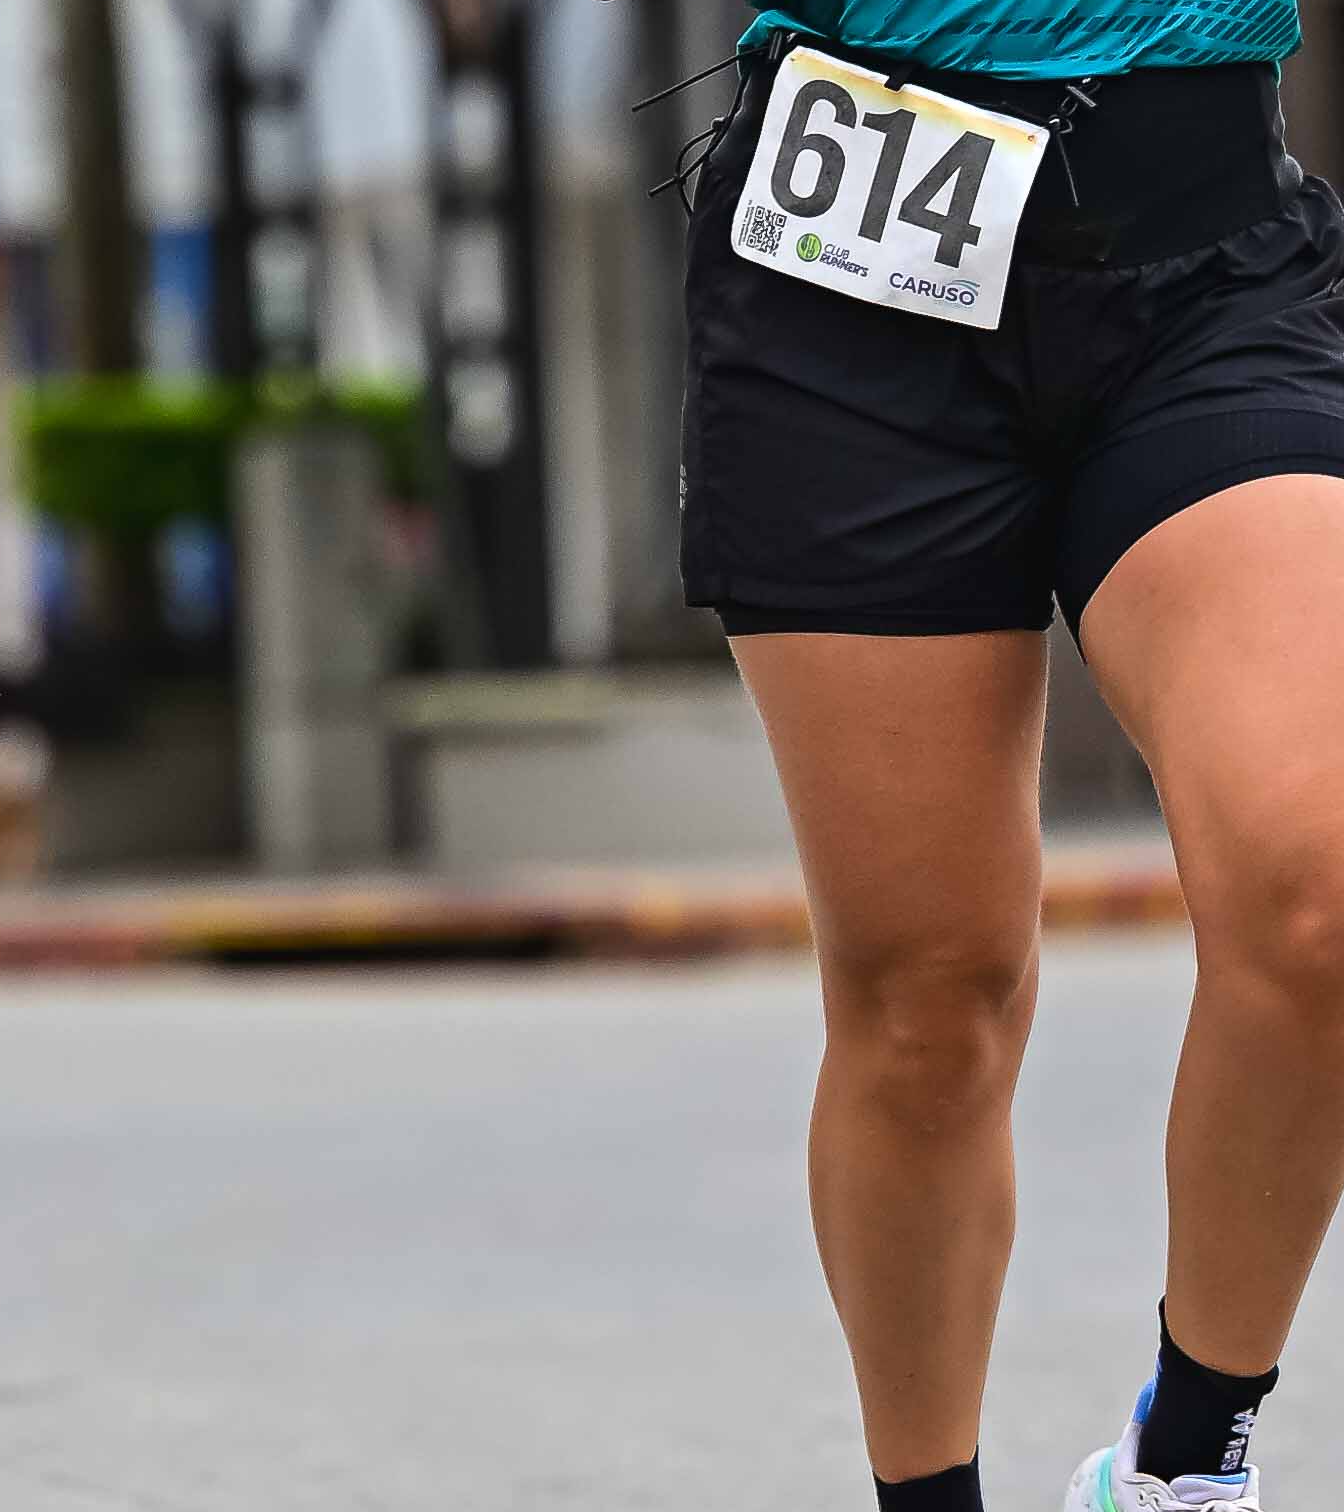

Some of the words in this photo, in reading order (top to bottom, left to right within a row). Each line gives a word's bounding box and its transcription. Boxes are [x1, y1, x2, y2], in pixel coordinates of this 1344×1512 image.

[770, 79, 996, 269] 614
[824, 243, 850, 260] CLUB
[889, 272, 975, 306] CARUSO
